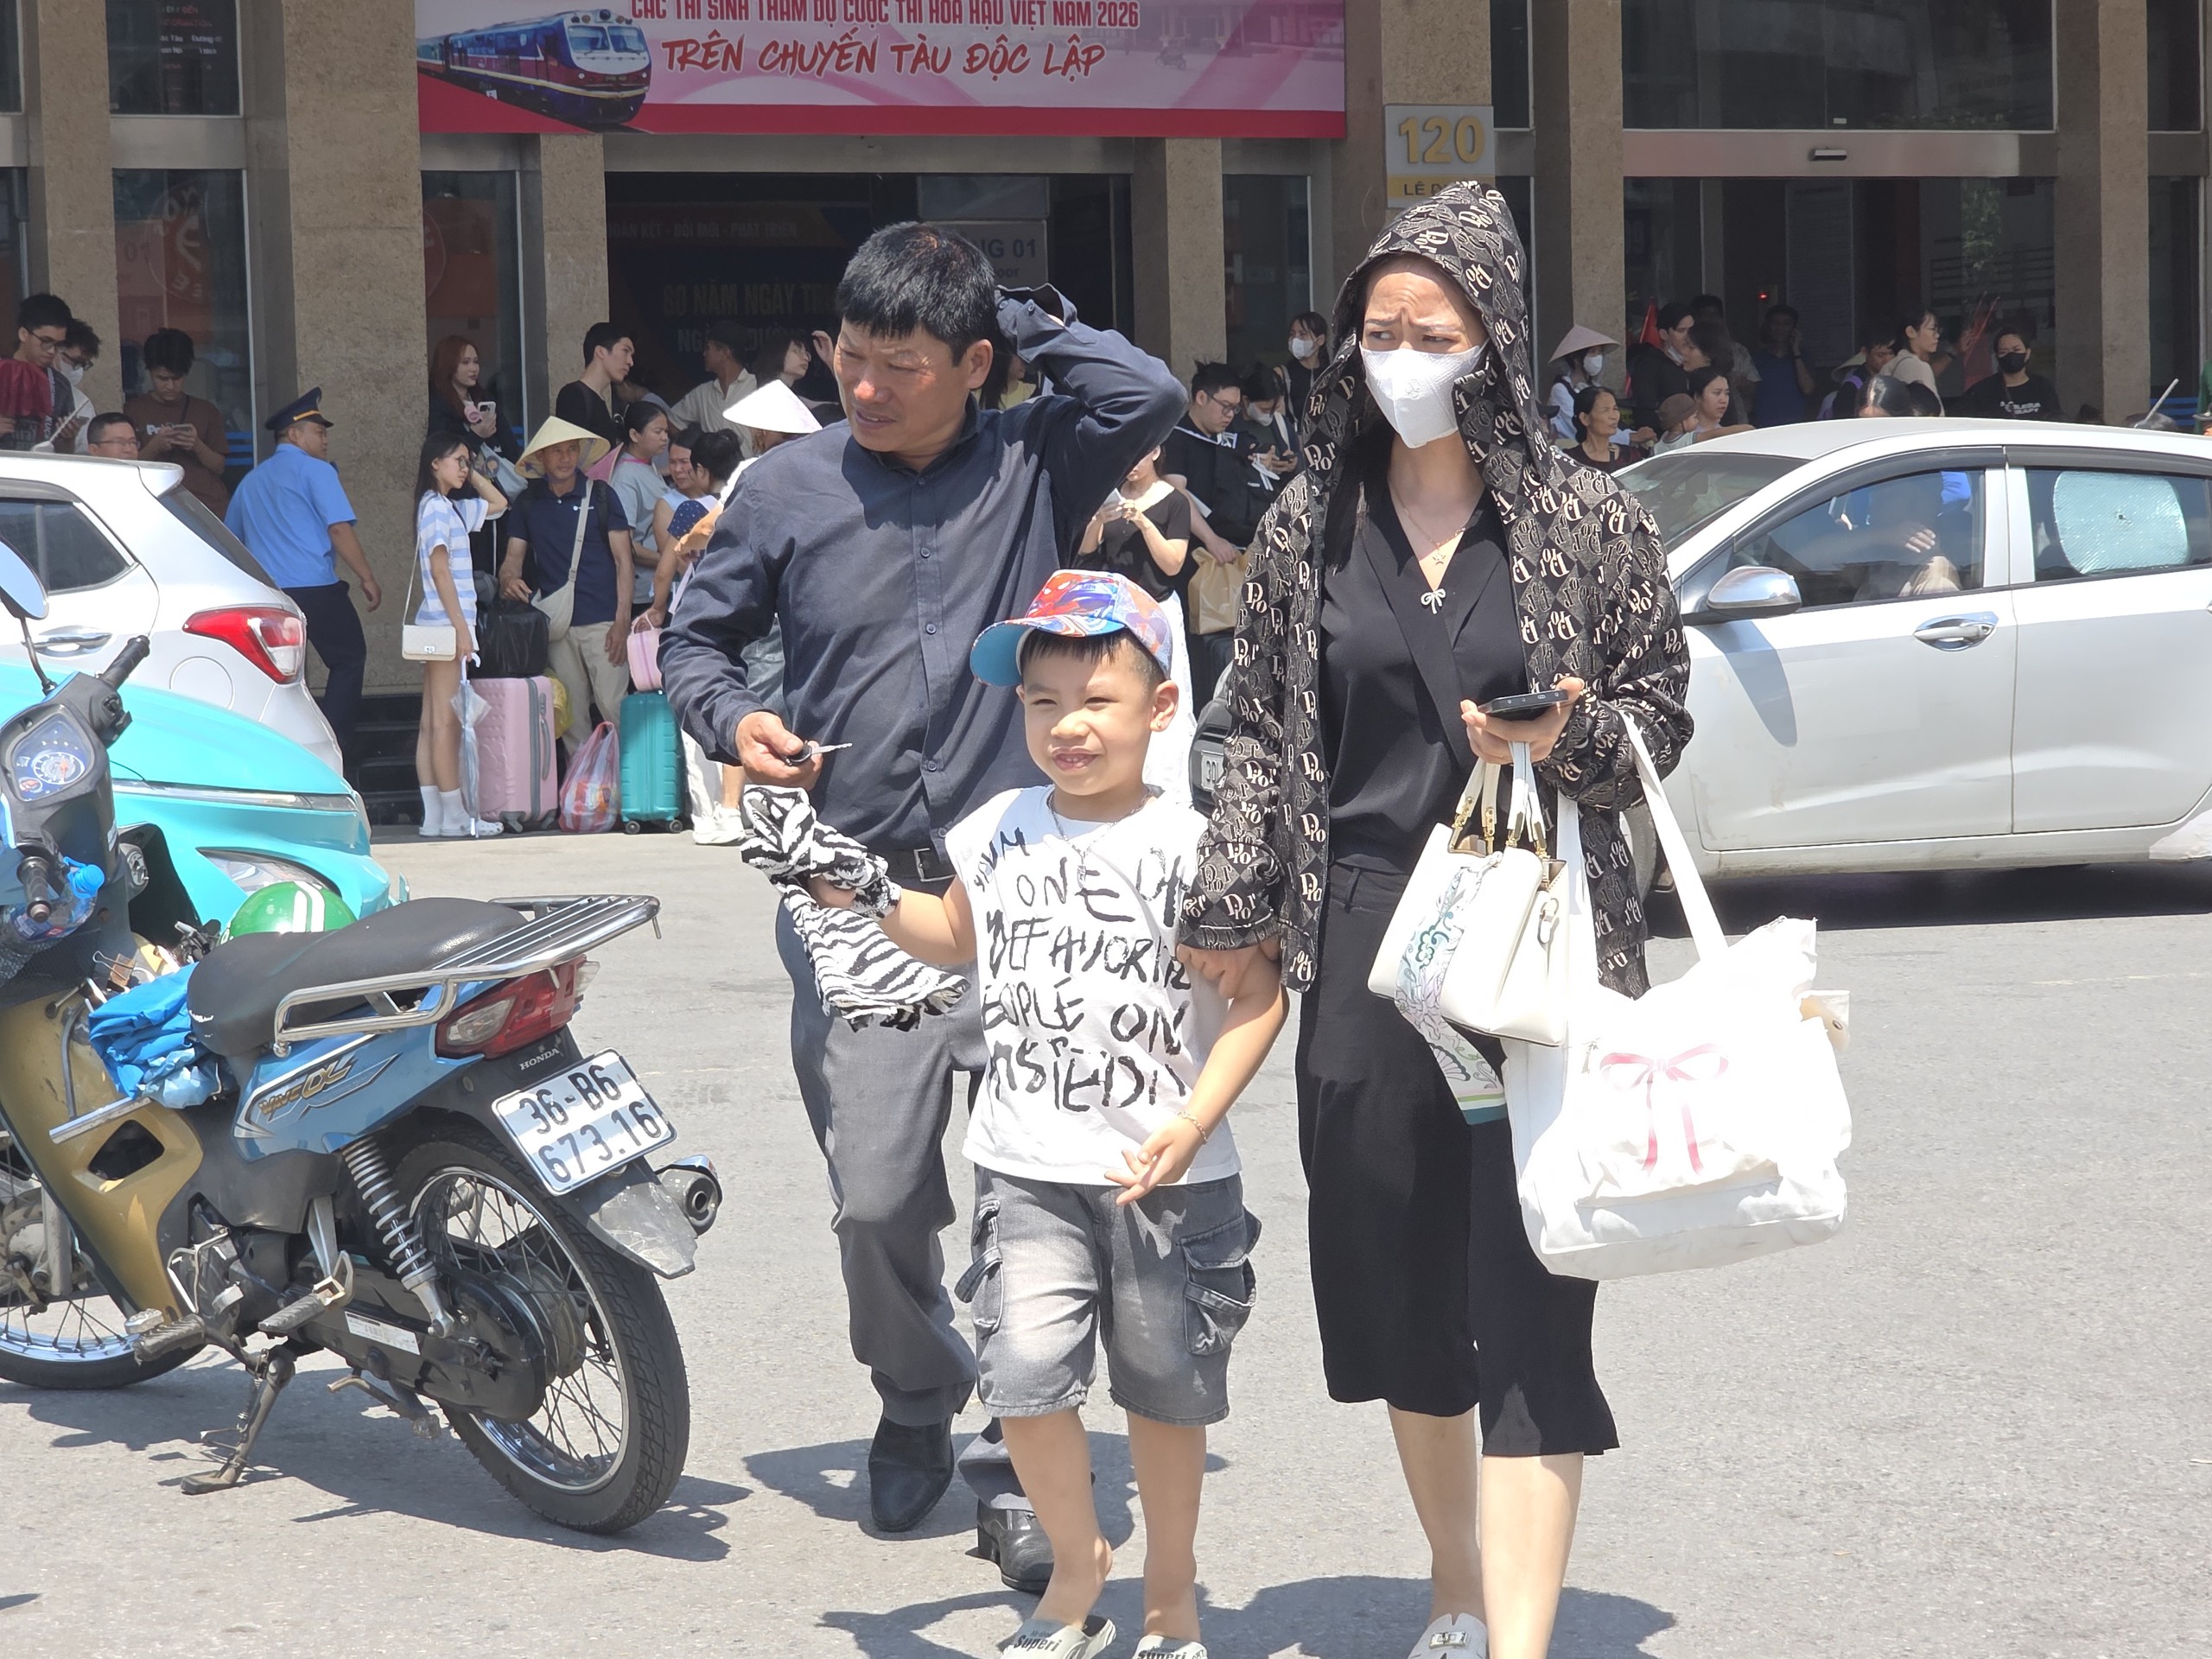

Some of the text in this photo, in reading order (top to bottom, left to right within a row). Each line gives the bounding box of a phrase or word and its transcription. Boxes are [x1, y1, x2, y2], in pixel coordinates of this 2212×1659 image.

[708, 0, 749, 21] SINH
[759, 0, 807, 22] THAM
[895, 0, 923, 23] THI
[929, 0, 963, 24] HOA
[1052, 1, 1091, 26] NAM
[1097, 2, 1139, 27] 2026
[662, 27, 1105, 82] TRÊN CHUYẾN TÀU ĐỘC LẬP
[1399, 115, 1484, 163] 120
[1404, 181, 1425, 196] LÊ
[1013, 239, 1036, 258] 01
[1110, 1000, 1190, 1056] ON
[519, 1048, 561, 1071] HONDA
[518, 1064, 622, 1135] 36-B6
[537, 1100, 663, 1184] 673.16
